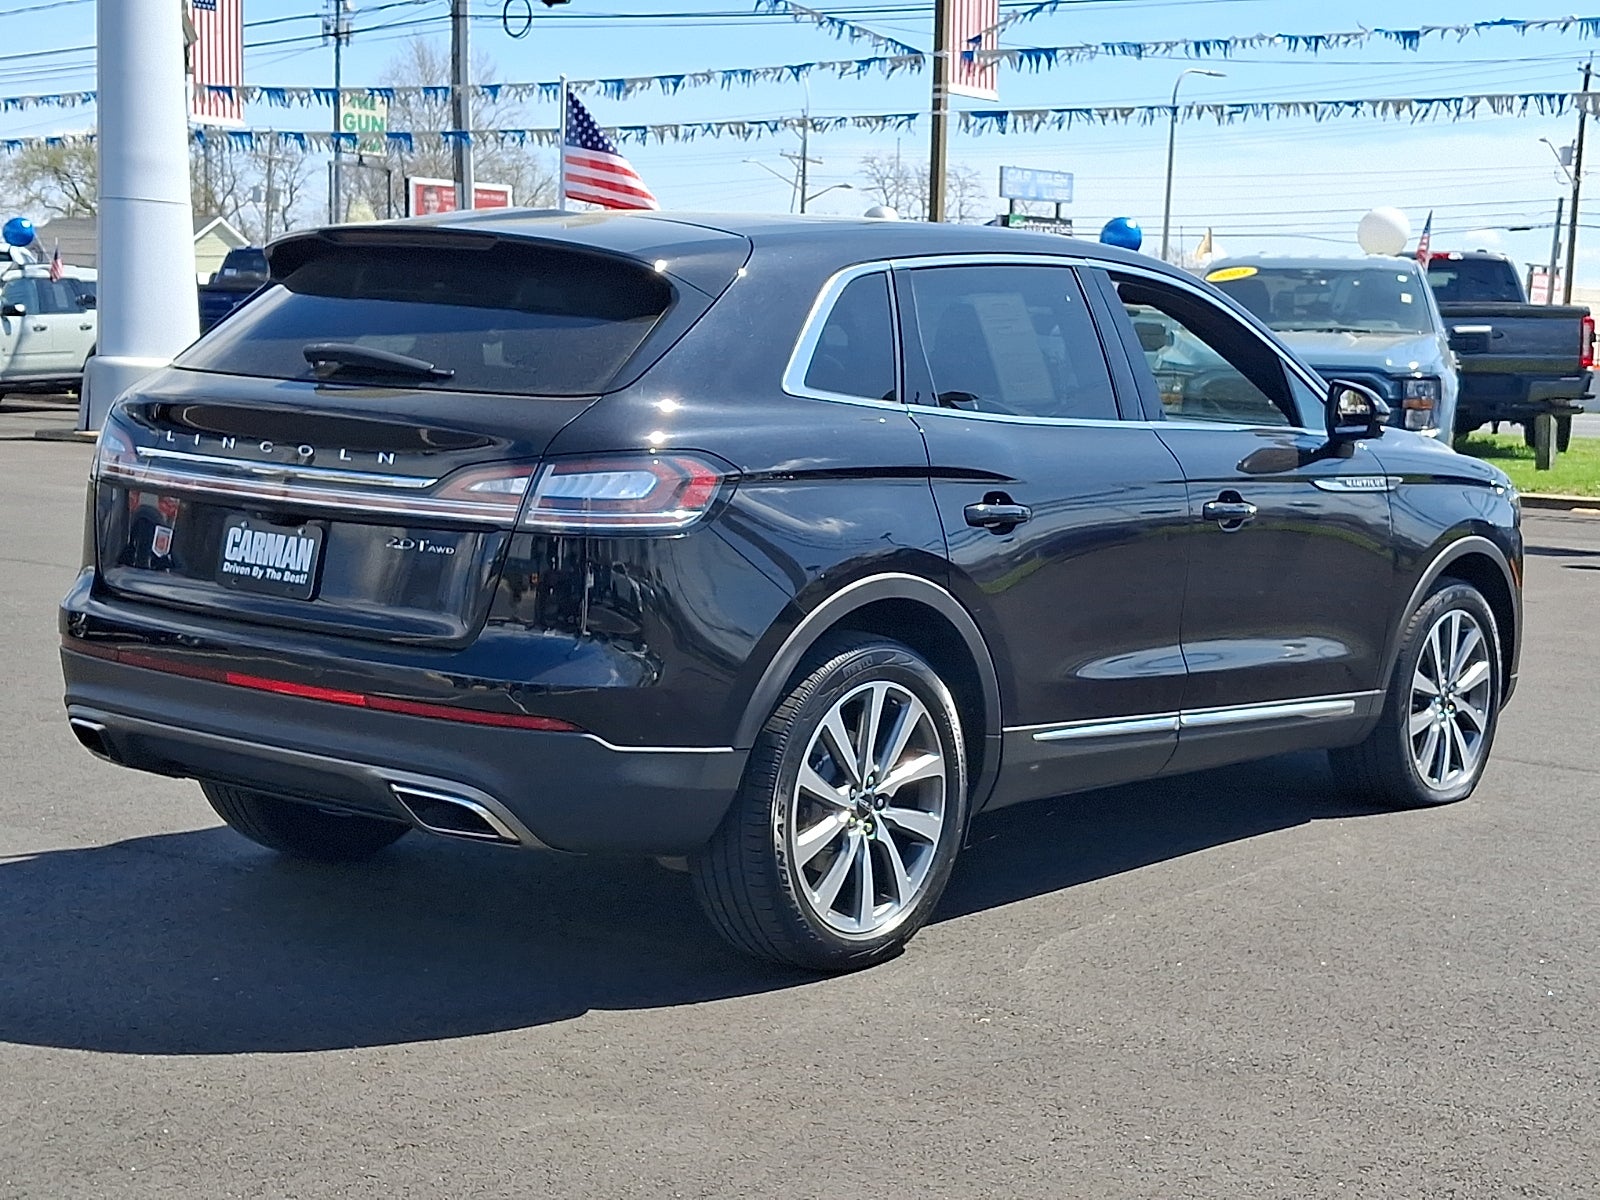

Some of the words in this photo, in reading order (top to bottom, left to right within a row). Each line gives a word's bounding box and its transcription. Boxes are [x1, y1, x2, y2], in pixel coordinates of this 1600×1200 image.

[343, 112, 384, 133] GUN
[1007, 169, 1032, 183] CAR
[166, 430, 395, 464] LINCOLN
[1345, 479, 1385, 487] NAUTILUS
[224, 526, 315, 572] CARMAN
[427, 545, 455, 555] AWD
[222, 561, 251, 576] Driven
[251, 565, 264, 580] By
[265, 567, 282, 581] The
[282, 570, 308, 585] Best!
